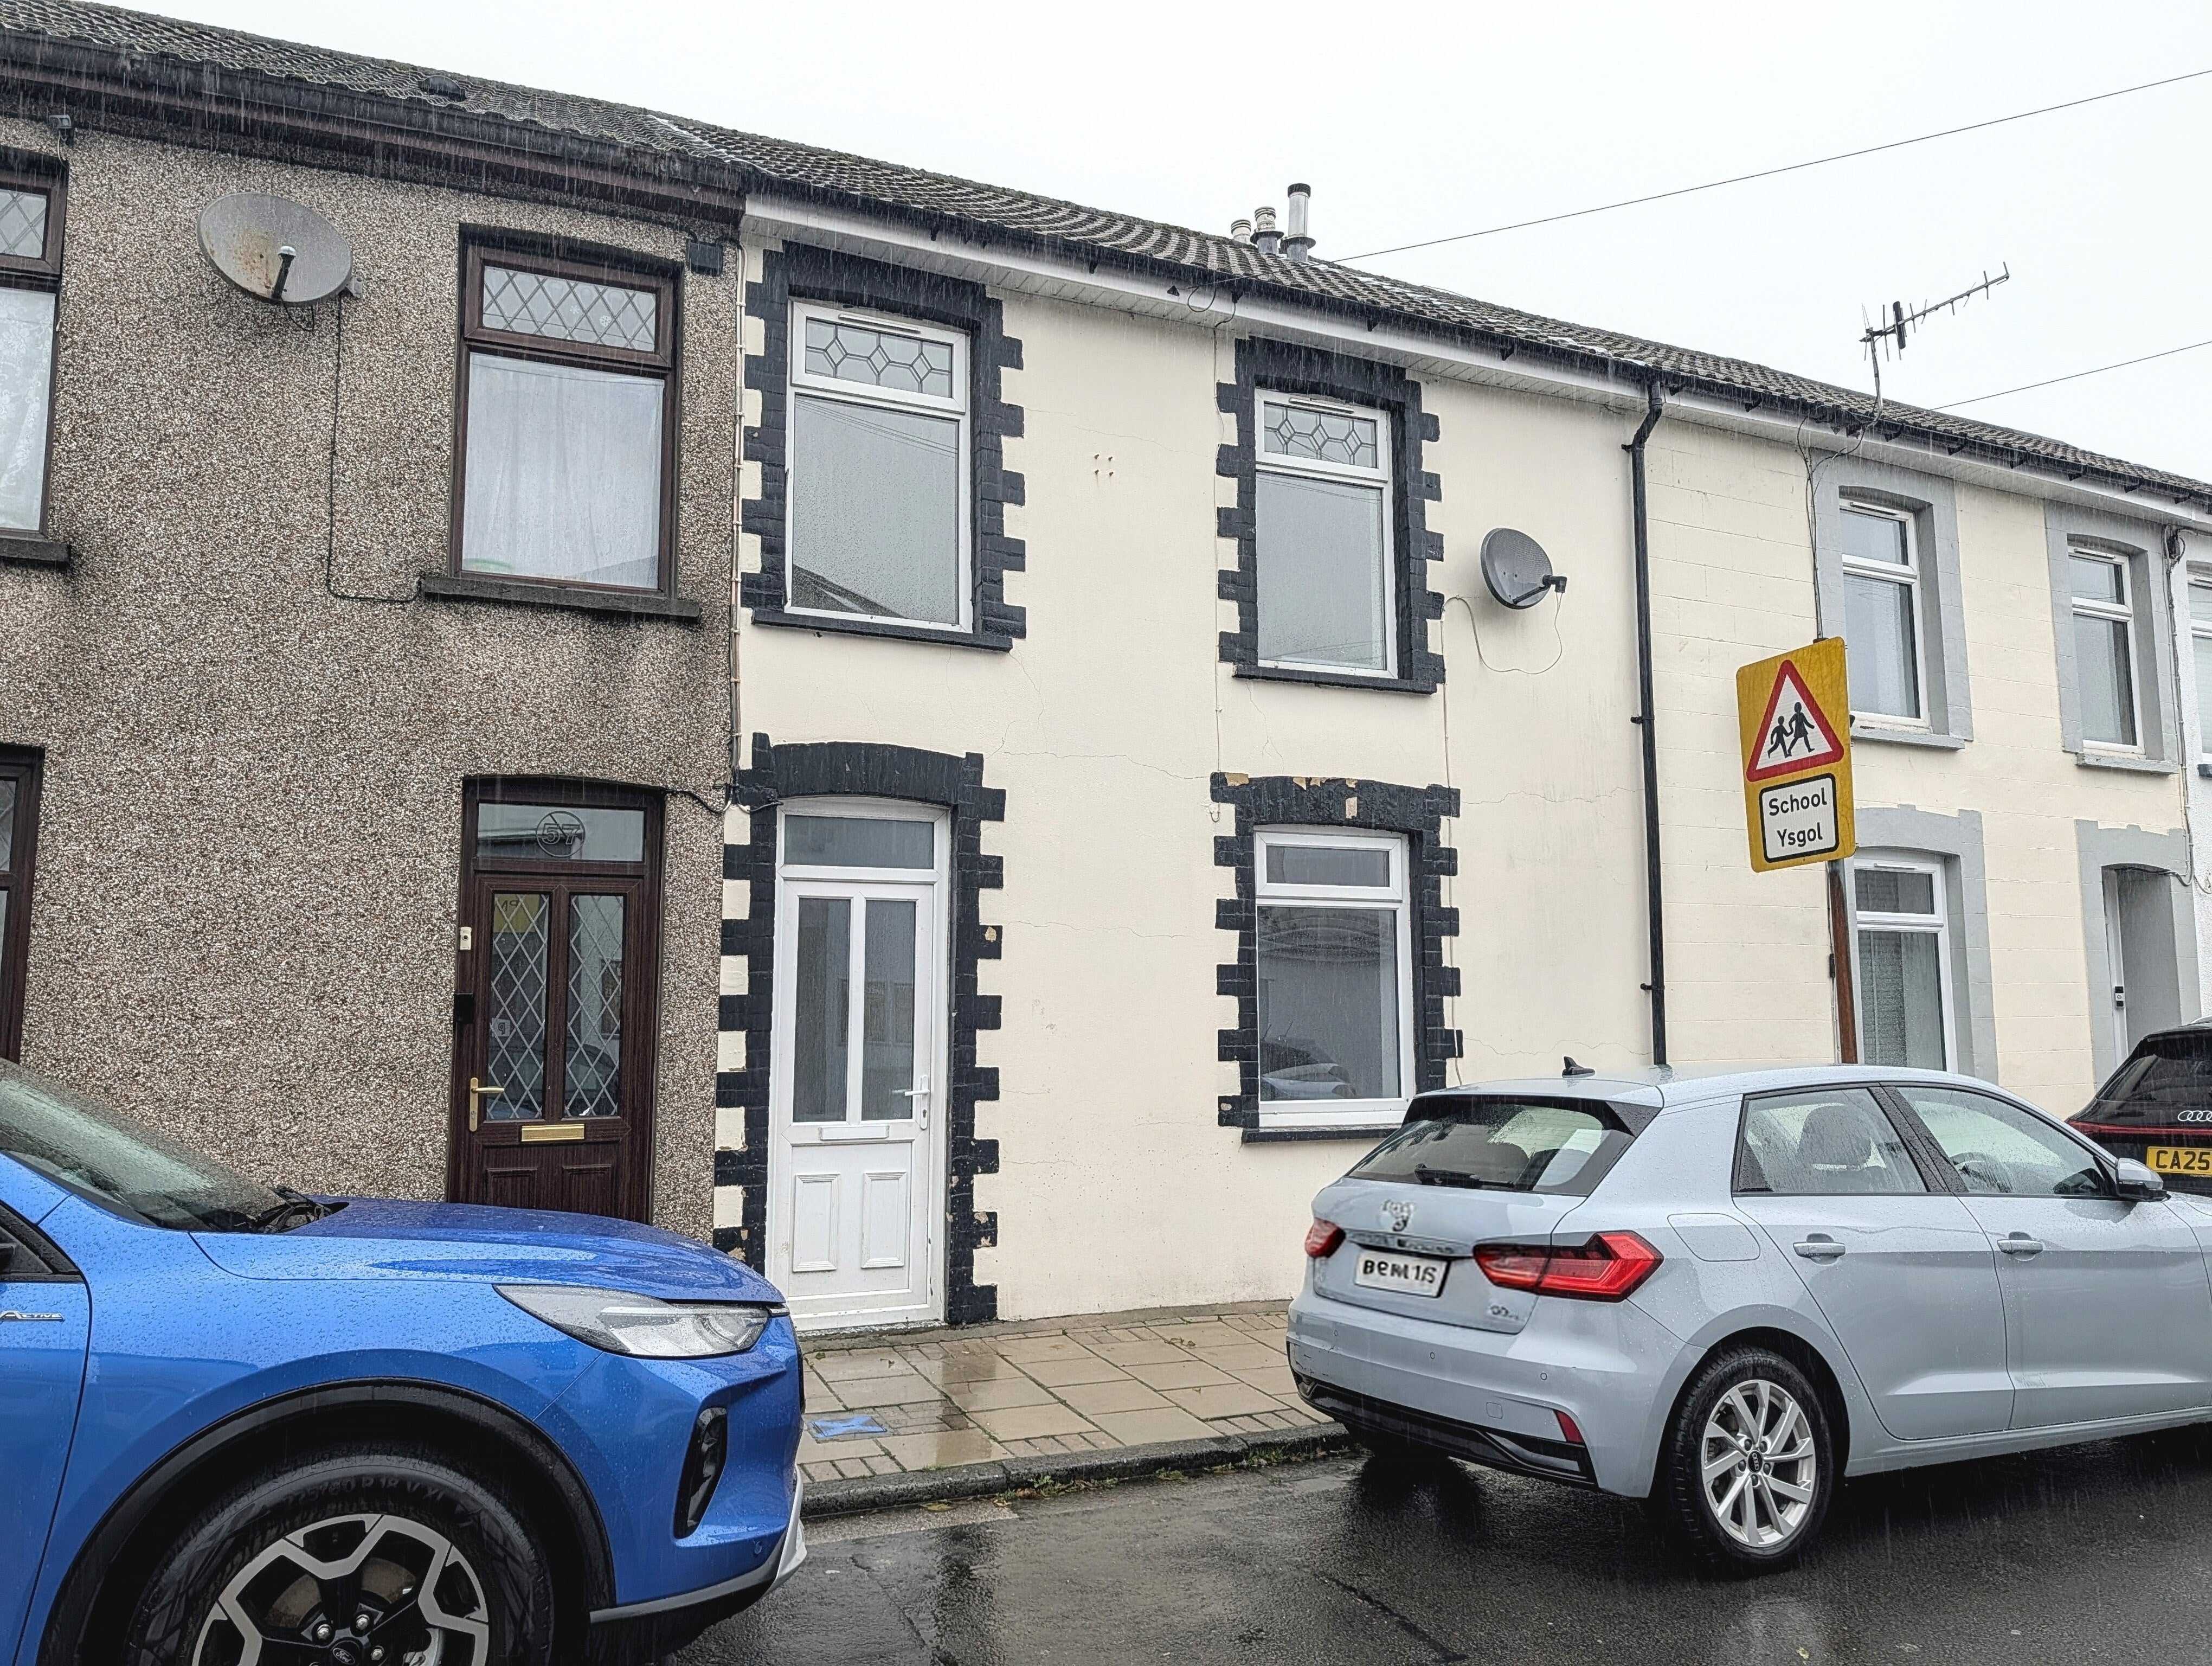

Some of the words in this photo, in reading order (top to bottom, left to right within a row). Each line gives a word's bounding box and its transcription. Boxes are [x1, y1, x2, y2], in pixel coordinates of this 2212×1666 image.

[1769, 787, 1827, 816] School
[541, 823, 581, 845] 57
[1777, 822, 1823, 847] Ysgol
[2155, 1149, 2210, 1171] CA25
